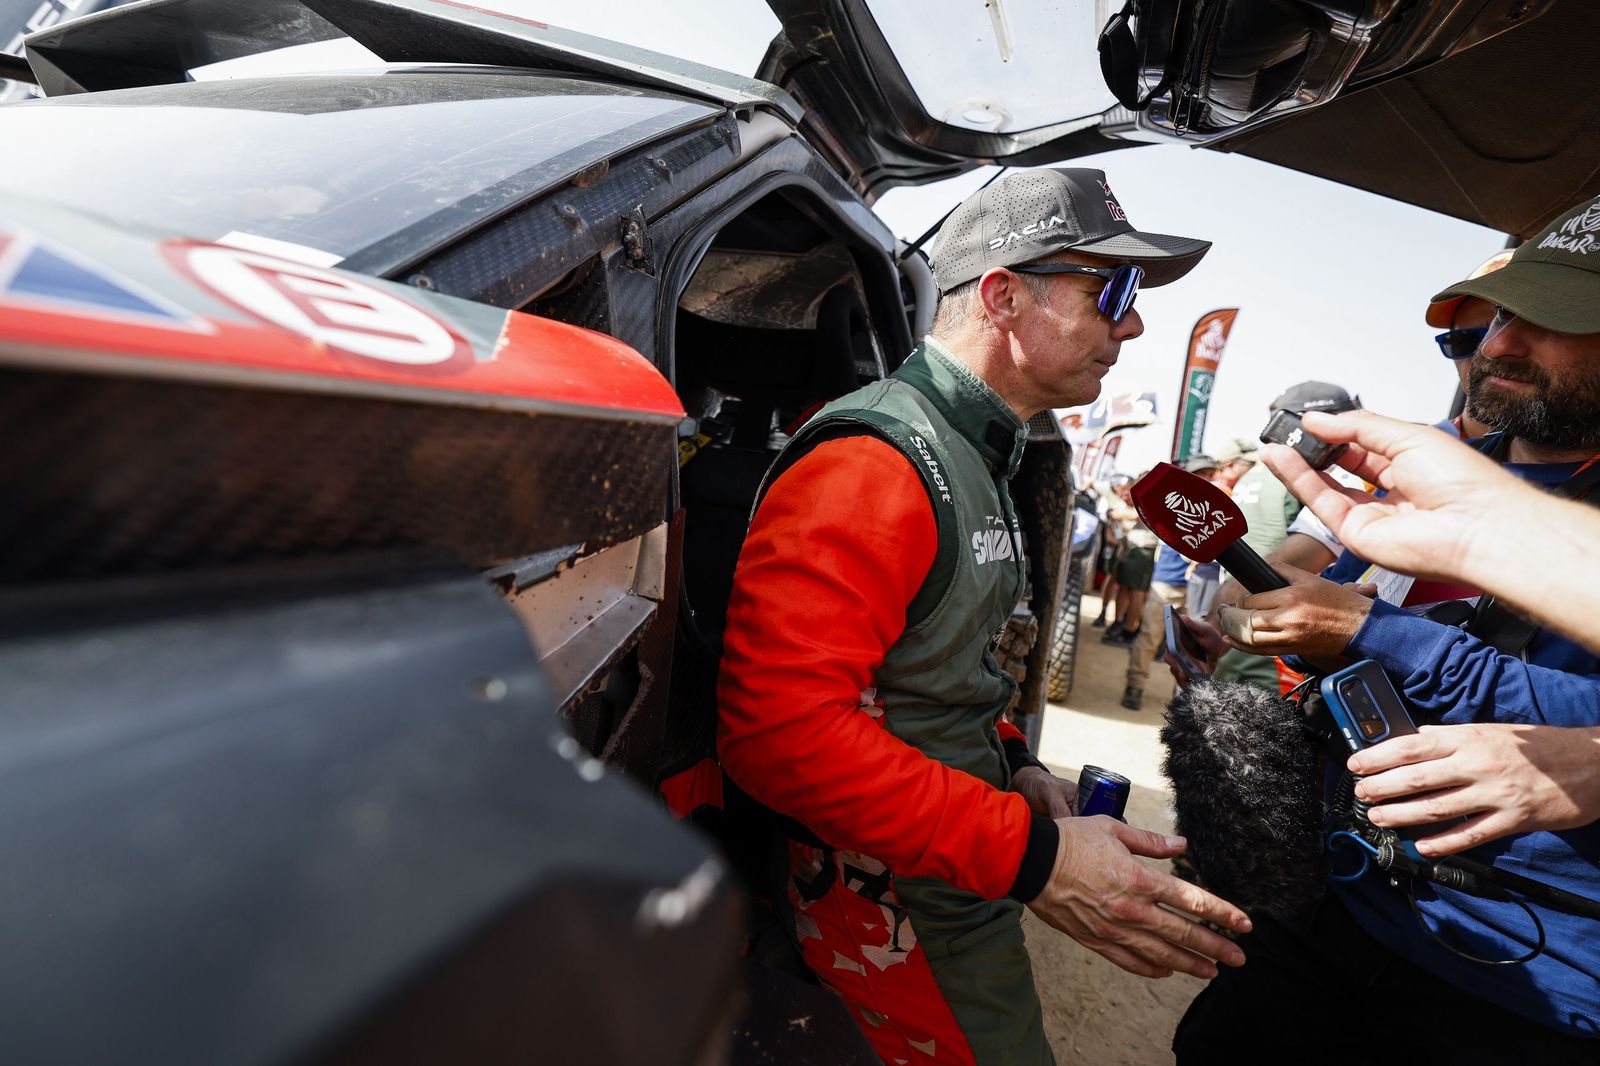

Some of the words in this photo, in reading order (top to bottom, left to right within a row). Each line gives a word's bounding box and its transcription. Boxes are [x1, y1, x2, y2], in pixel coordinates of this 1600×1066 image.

[989, 215, 1065, 250] DACIA
[1537, 231, 1588, 254] DAKAR
[909, 435, 951, 503] Sabelt
[1181, 510, 1233, 549] DAKAR
